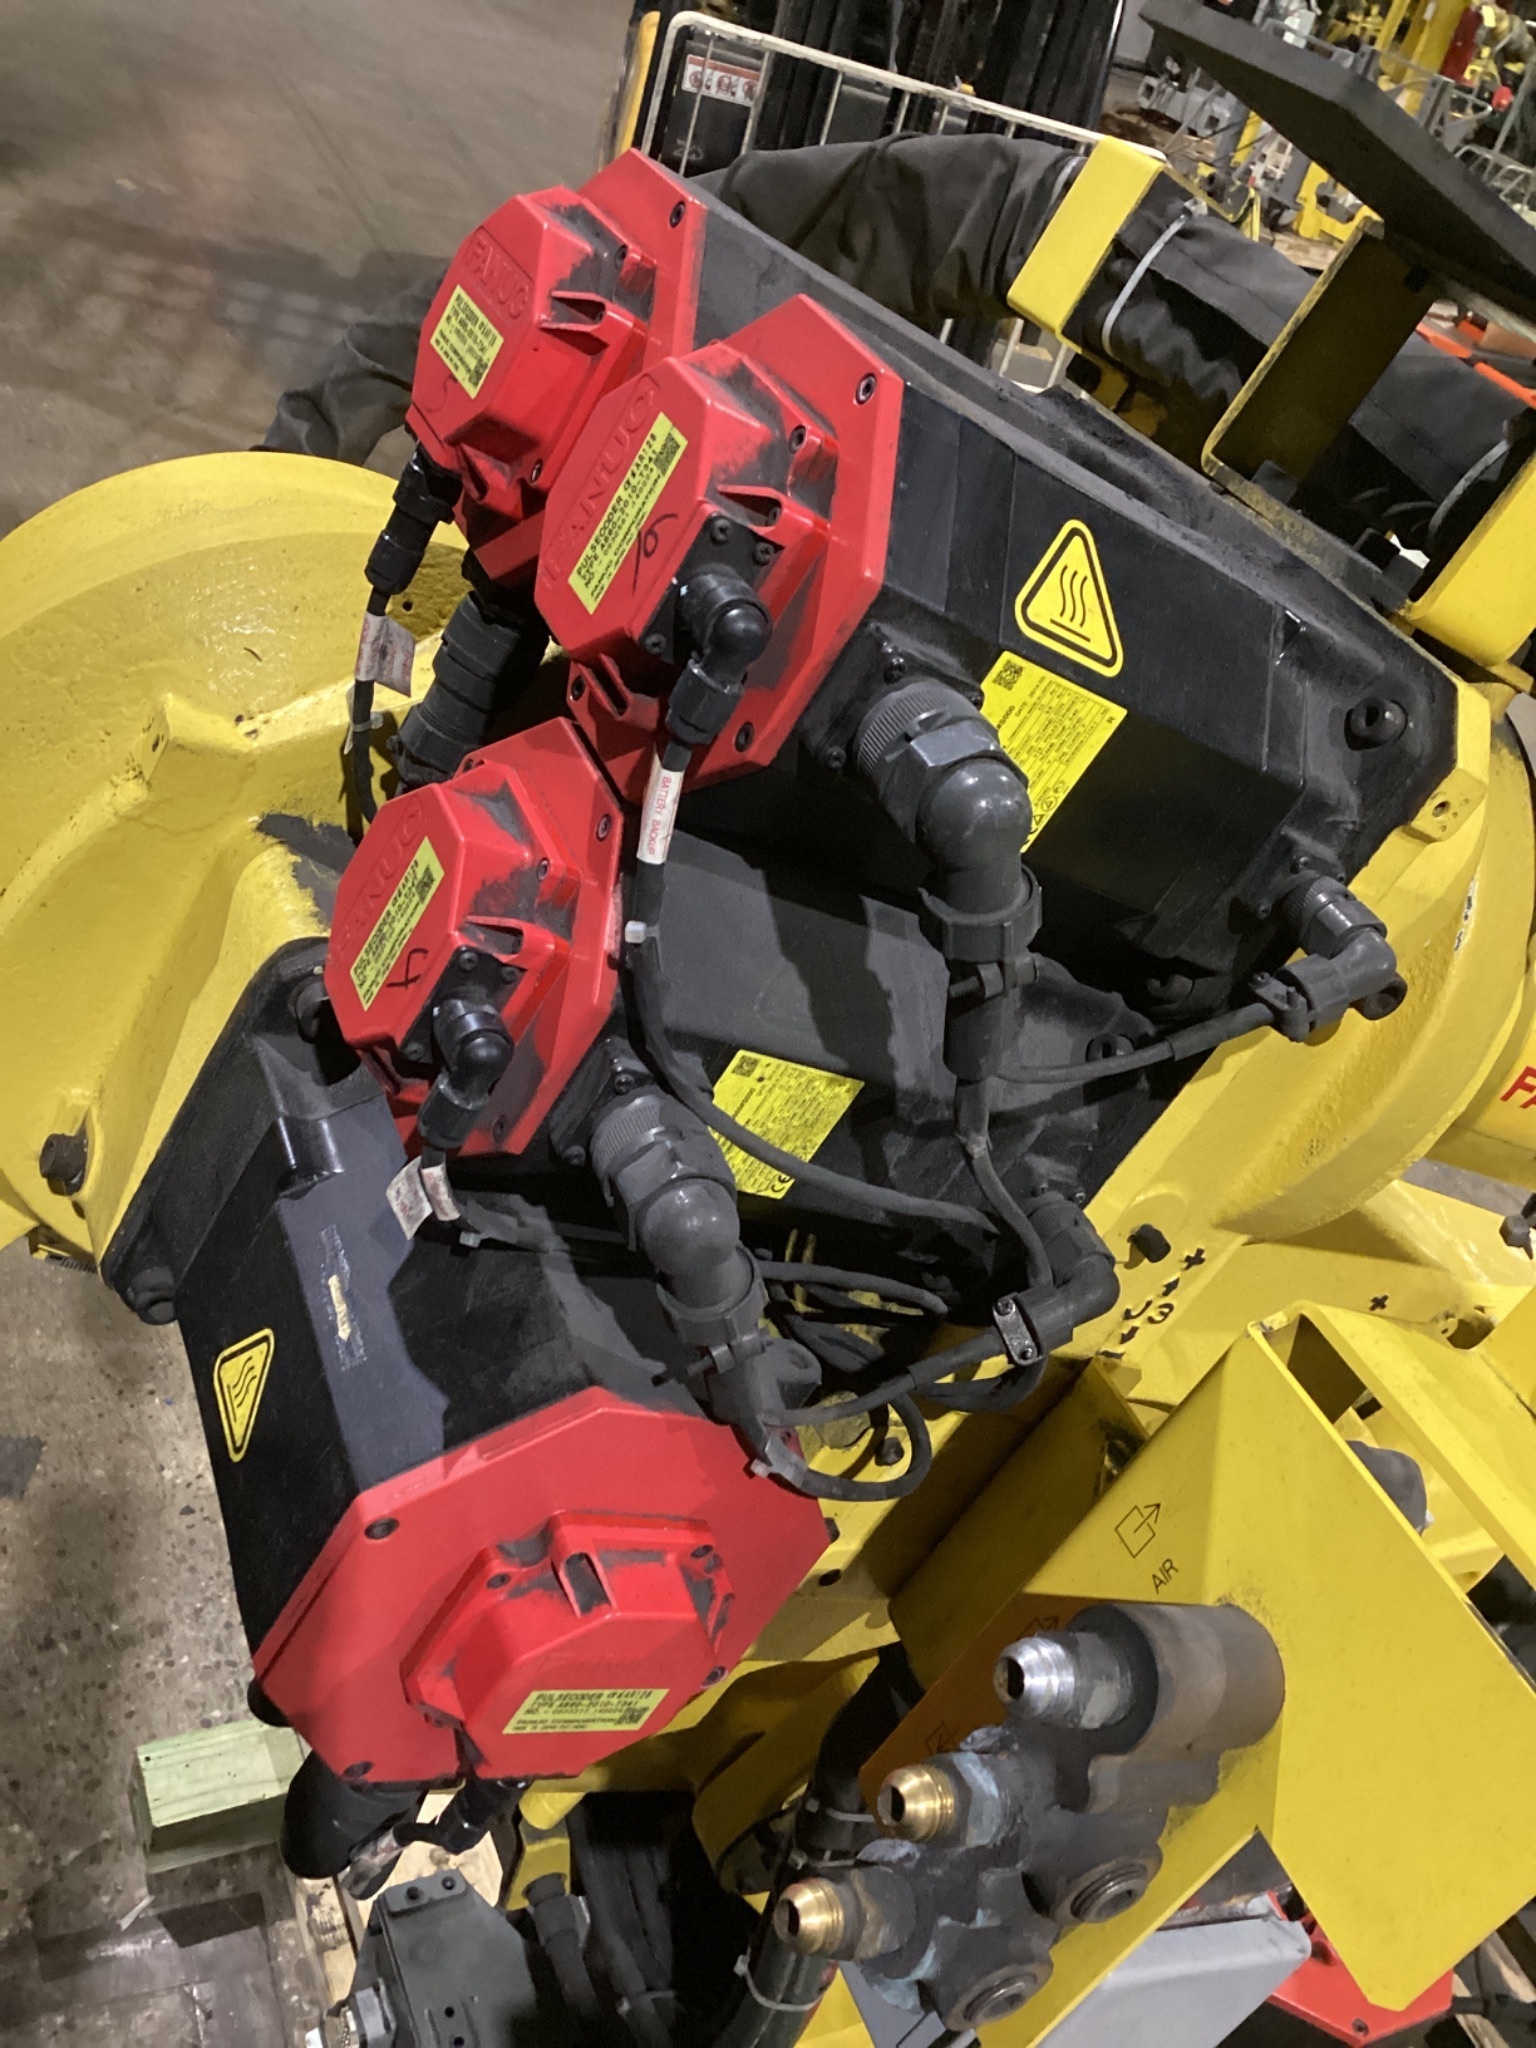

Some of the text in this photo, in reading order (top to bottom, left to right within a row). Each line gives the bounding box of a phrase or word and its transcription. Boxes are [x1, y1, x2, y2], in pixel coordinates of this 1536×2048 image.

[542, 387, 656, 590] FANUC
[613, 472, 660, 556] CORPORATION
[576, 494, 623, 577] PULSECODER
[581, 552, 598, 581] TYPE
[1105, 715, 1115, 724] R
[648, 776, 671, 856] BATTERY BACKUP
[353, 908, 391, 977] PULSECODER
[1122, 1299, 1175, 1325] J3
[1152, 1557, 1179, 1595] AIR
[534, 1692, 604, 1700] PULSECODER
